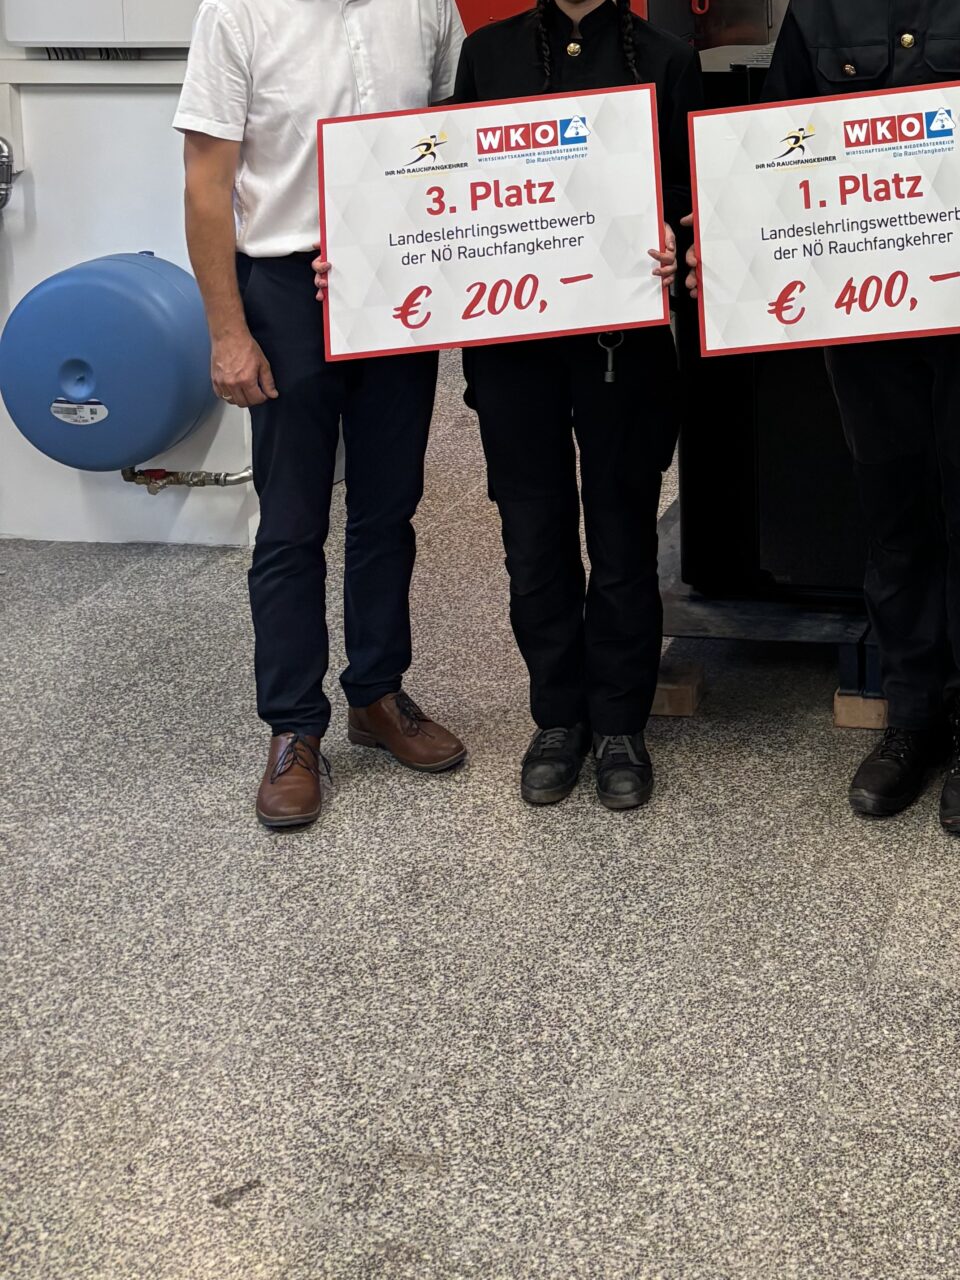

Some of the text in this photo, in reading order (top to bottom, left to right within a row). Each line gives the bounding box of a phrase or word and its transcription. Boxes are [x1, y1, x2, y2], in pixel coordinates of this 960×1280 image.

[478, 125, 555, 150] WKO
[845, 117, 920, 143] WKO
[478, 151, 536, 163] WIRTSCHAFTSKAMMER
[526, 152, 588, 165] Die Rauchfangkehrer
[776, 155, 837, 167] RAUCHFANGKEHRER
[846, 145, 903, 156] WIRTSCHAFTSKAMMER
[893, 146, 954, 158] Die Rauchfangkehrer
[407, 162, 469, 174] RAUCHFANGKEHRER
[425, 180, 556, 215] 3. Platz
[799, 173, 924, 209] 1. Platz
[389, 212, 596, 247] Landeslehrlingswettbewerb
[401, 234, 585, 266] der NÖ Rauchfangkehrer
[773, 230, 954, 260] der NÖ Rauchfangkehrer
[392, 285, 432, 329] €
[767, 280, 806, 325] €
